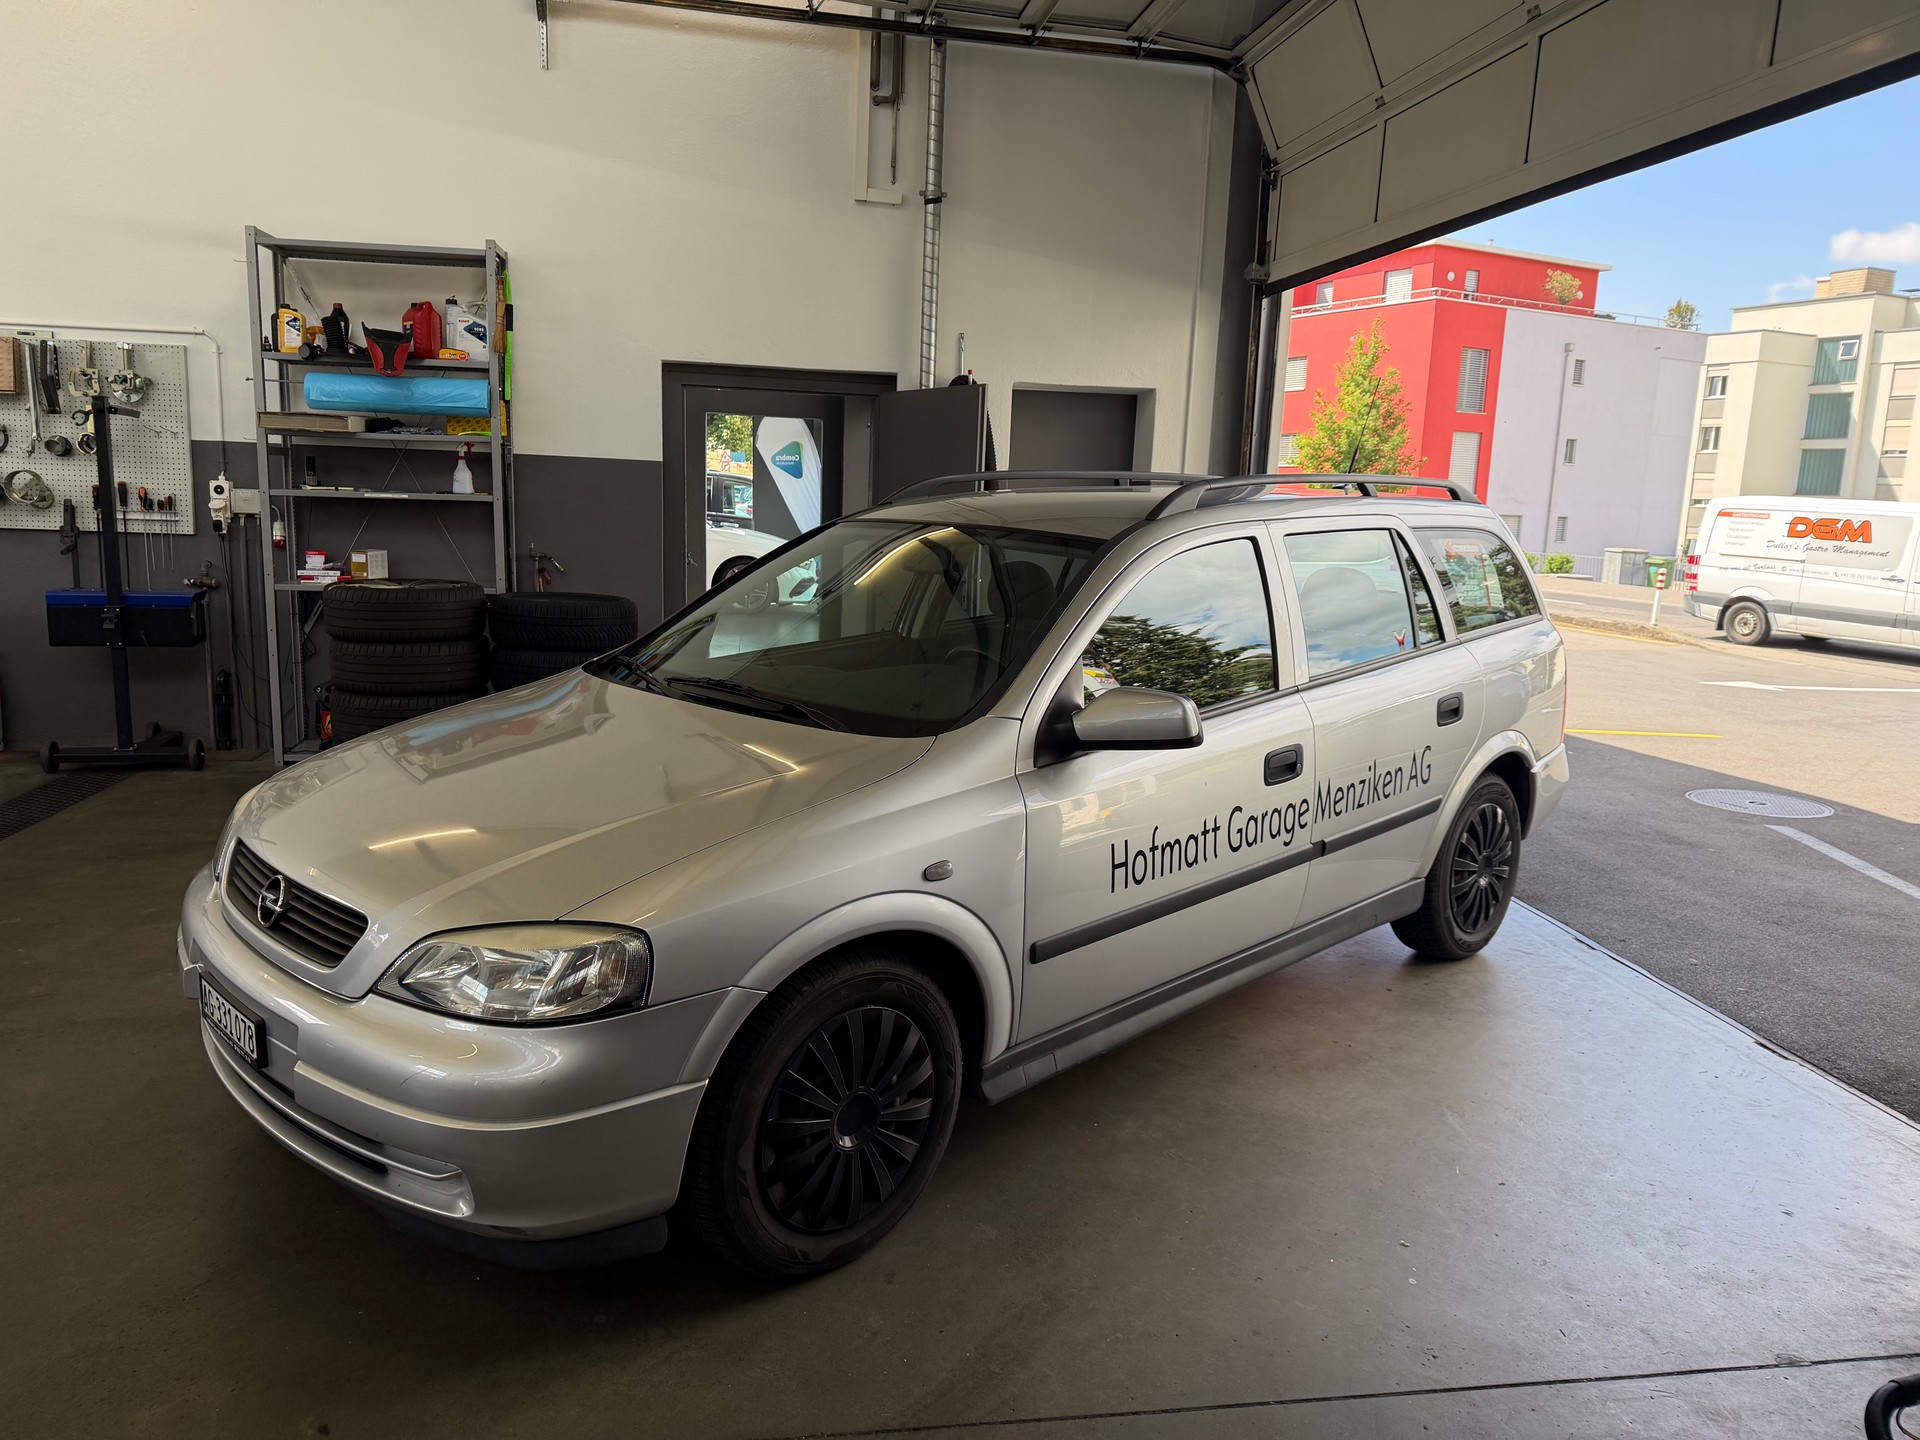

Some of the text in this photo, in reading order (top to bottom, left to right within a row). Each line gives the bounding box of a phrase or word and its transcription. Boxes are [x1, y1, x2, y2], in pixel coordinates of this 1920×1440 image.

[1786, 516, 1872, 543] DGM
[1802, 542, 1829, 553] Gastro
[1833, 544, 1890, 558] Management
[1110, 745, 1432, 893] Hofmatt Garage Menziken AG
